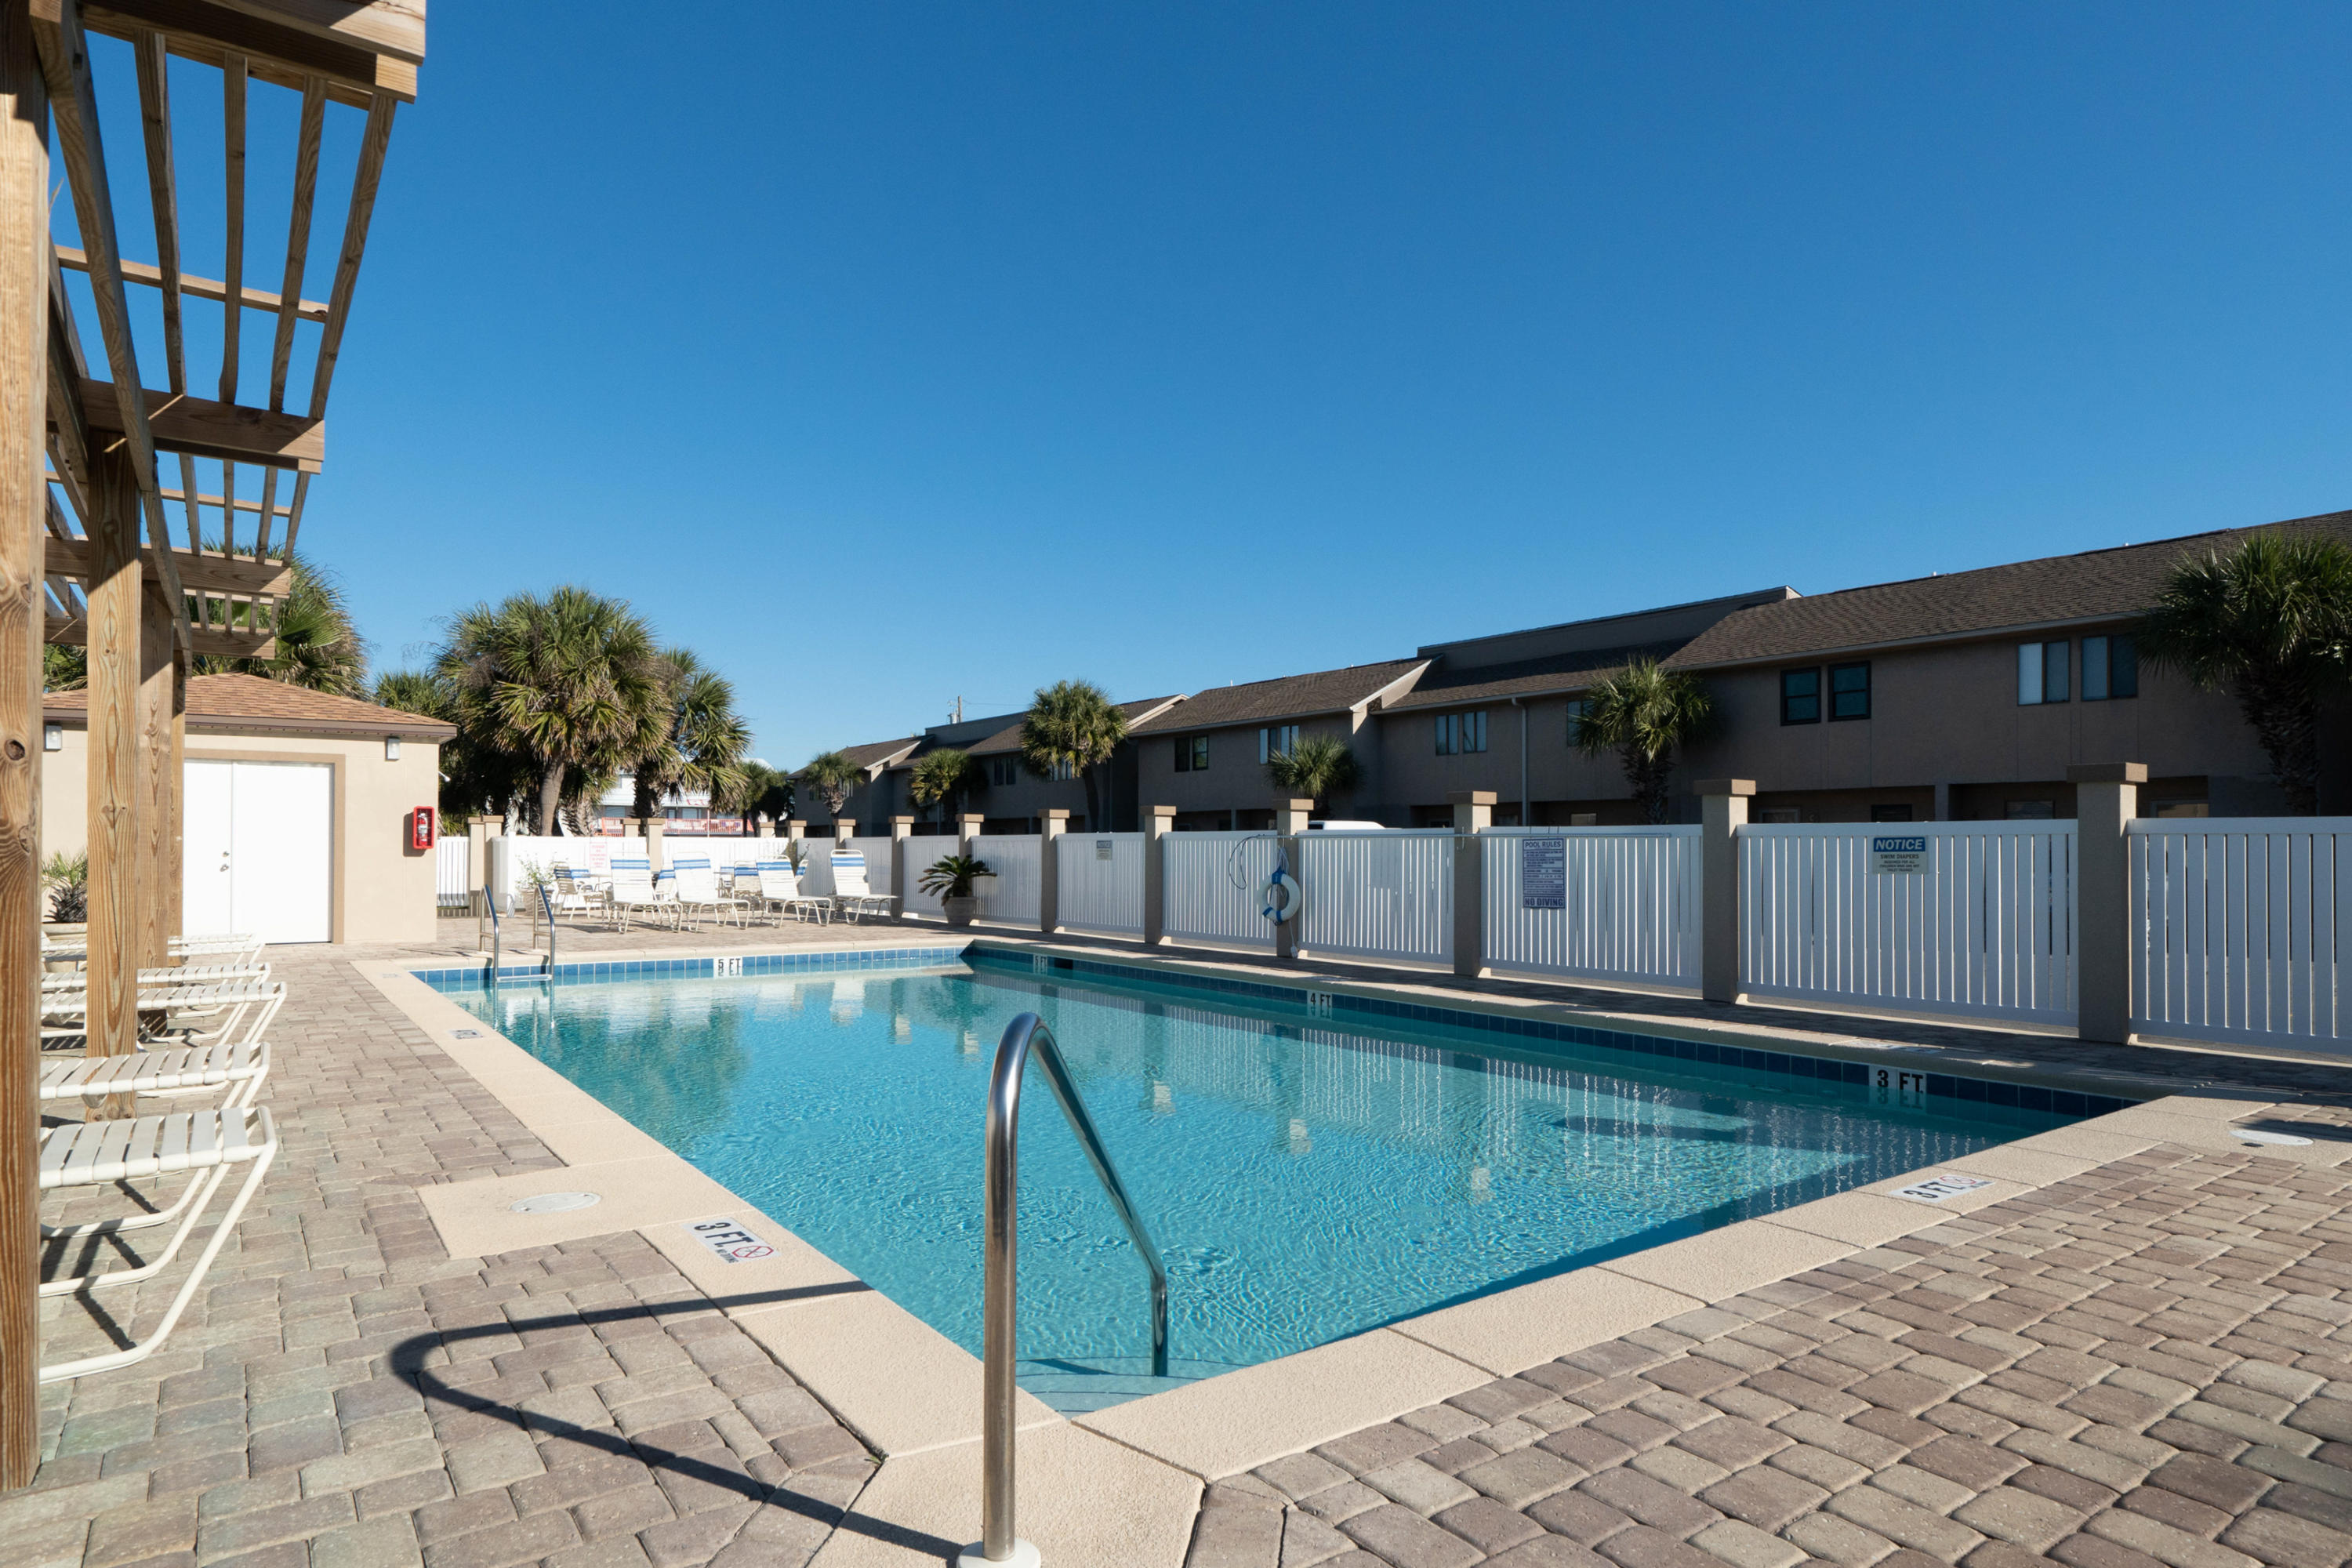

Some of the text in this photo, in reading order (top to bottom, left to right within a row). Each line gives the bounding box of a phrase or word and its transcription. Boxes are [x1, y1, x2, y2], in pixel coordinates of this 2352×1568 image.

[1875, 838, 1924, 850] NOTICE
[1537, 898, 1563, 906] DIVING
[1311, 993, 1316, 1005] 4
[1877, 1069, 1923, 1094] 3 FT.
[1903, 1189, 1939, 1199] 3
[694, 1221, 754, 1247] 3 FT.
